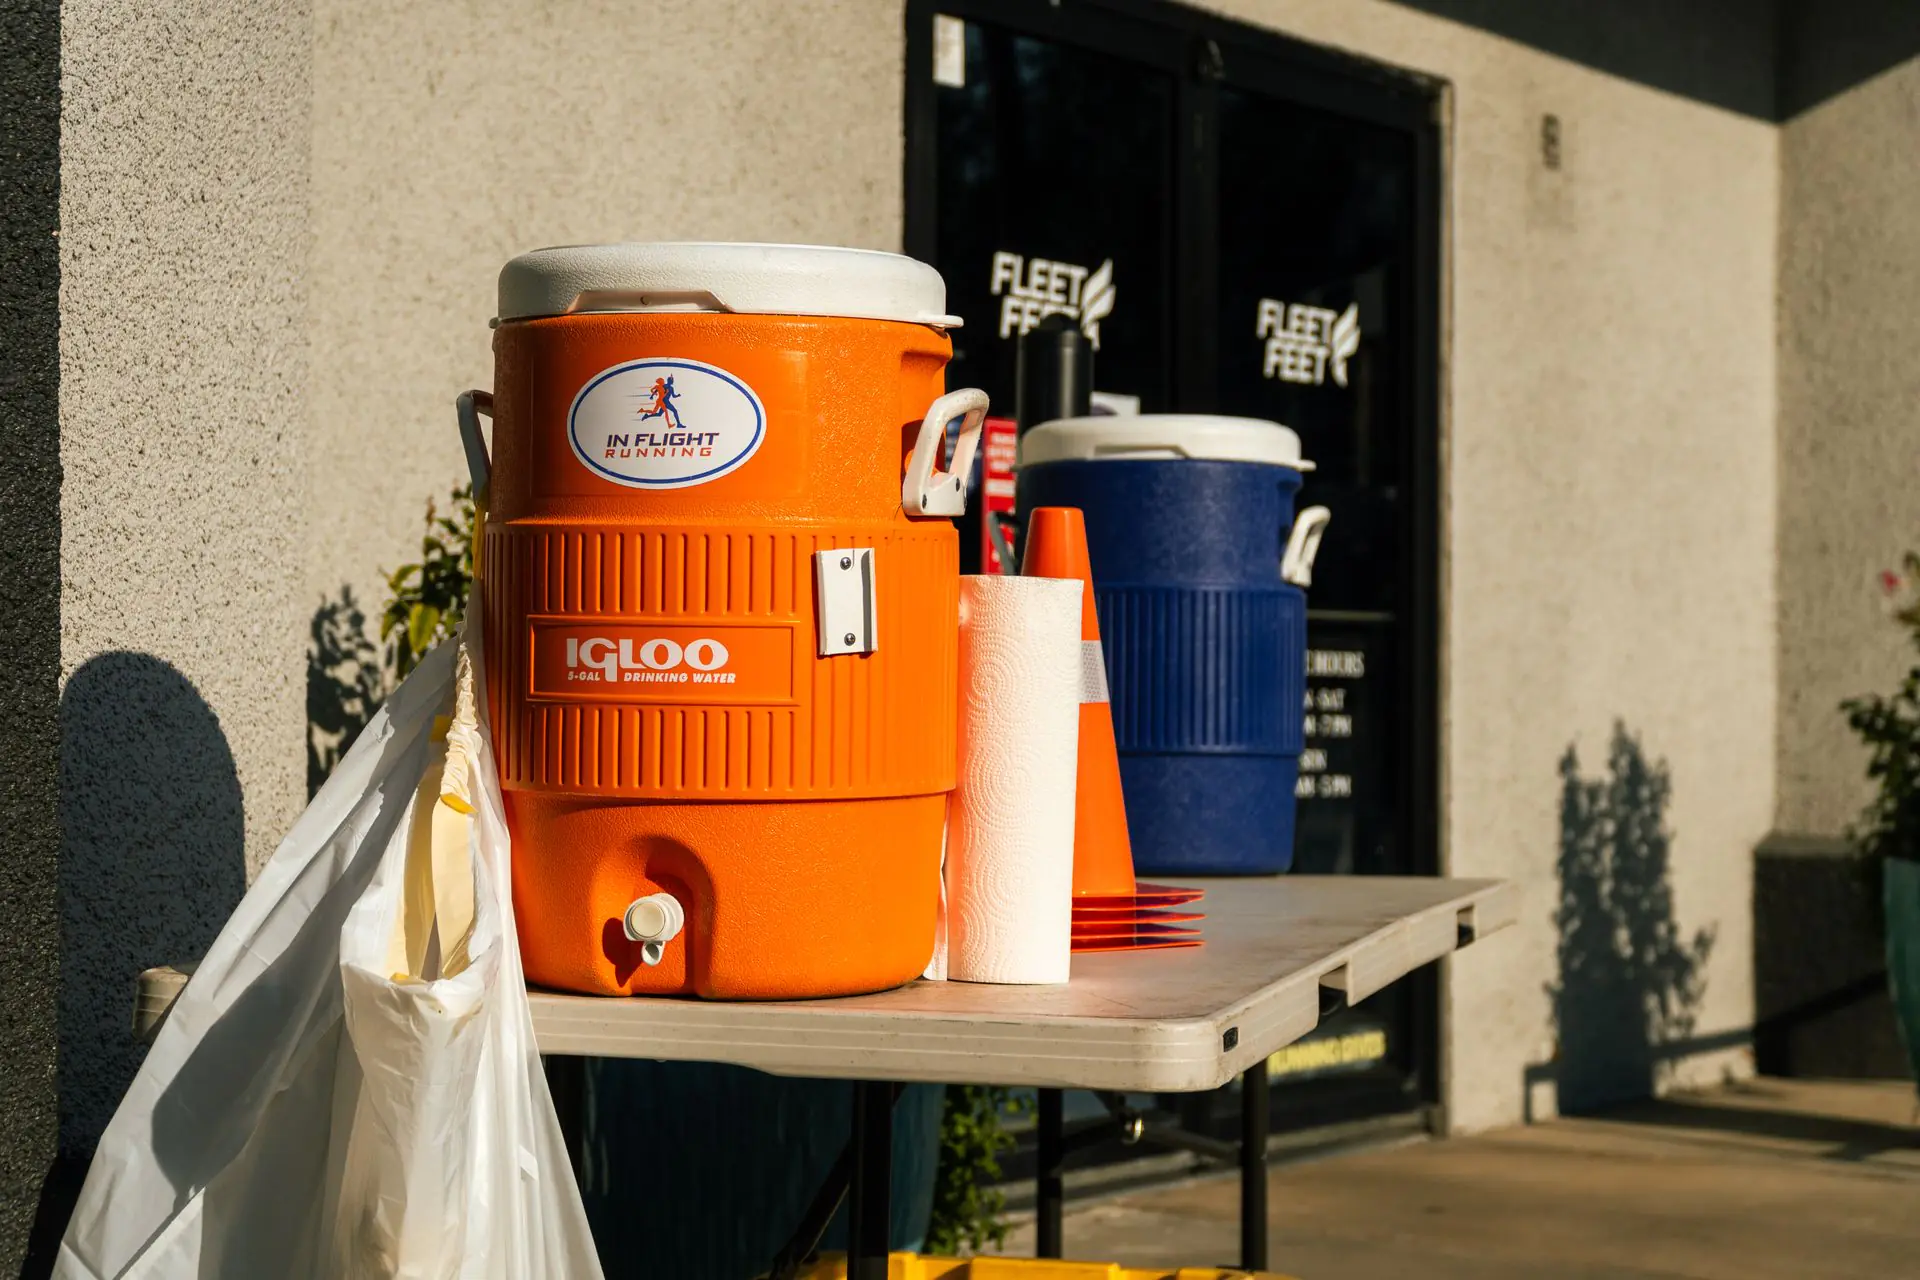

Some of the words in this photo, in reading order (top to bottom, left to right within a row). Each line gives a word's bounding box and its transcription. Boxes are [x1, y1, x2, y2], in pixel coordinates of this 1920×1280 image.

[991, 252, 1089, 305] FLEET
[999, 295, 1081, 339] FE
[1256, 299, 1338, 344] FLEET
[1263, 339, 1331, 386] FEET
[604, 447, 712, 459] RUNNING
[607, 434, 628, 447] IN
[634, 432, 720, 447] FLIGHT
[566, 637, 729, 682] IGLOO
[567, 671, 600, 681] 5-GAL
[623, 672, 688, 683] DRINKING
[692, 673, 736, 684] WATER
